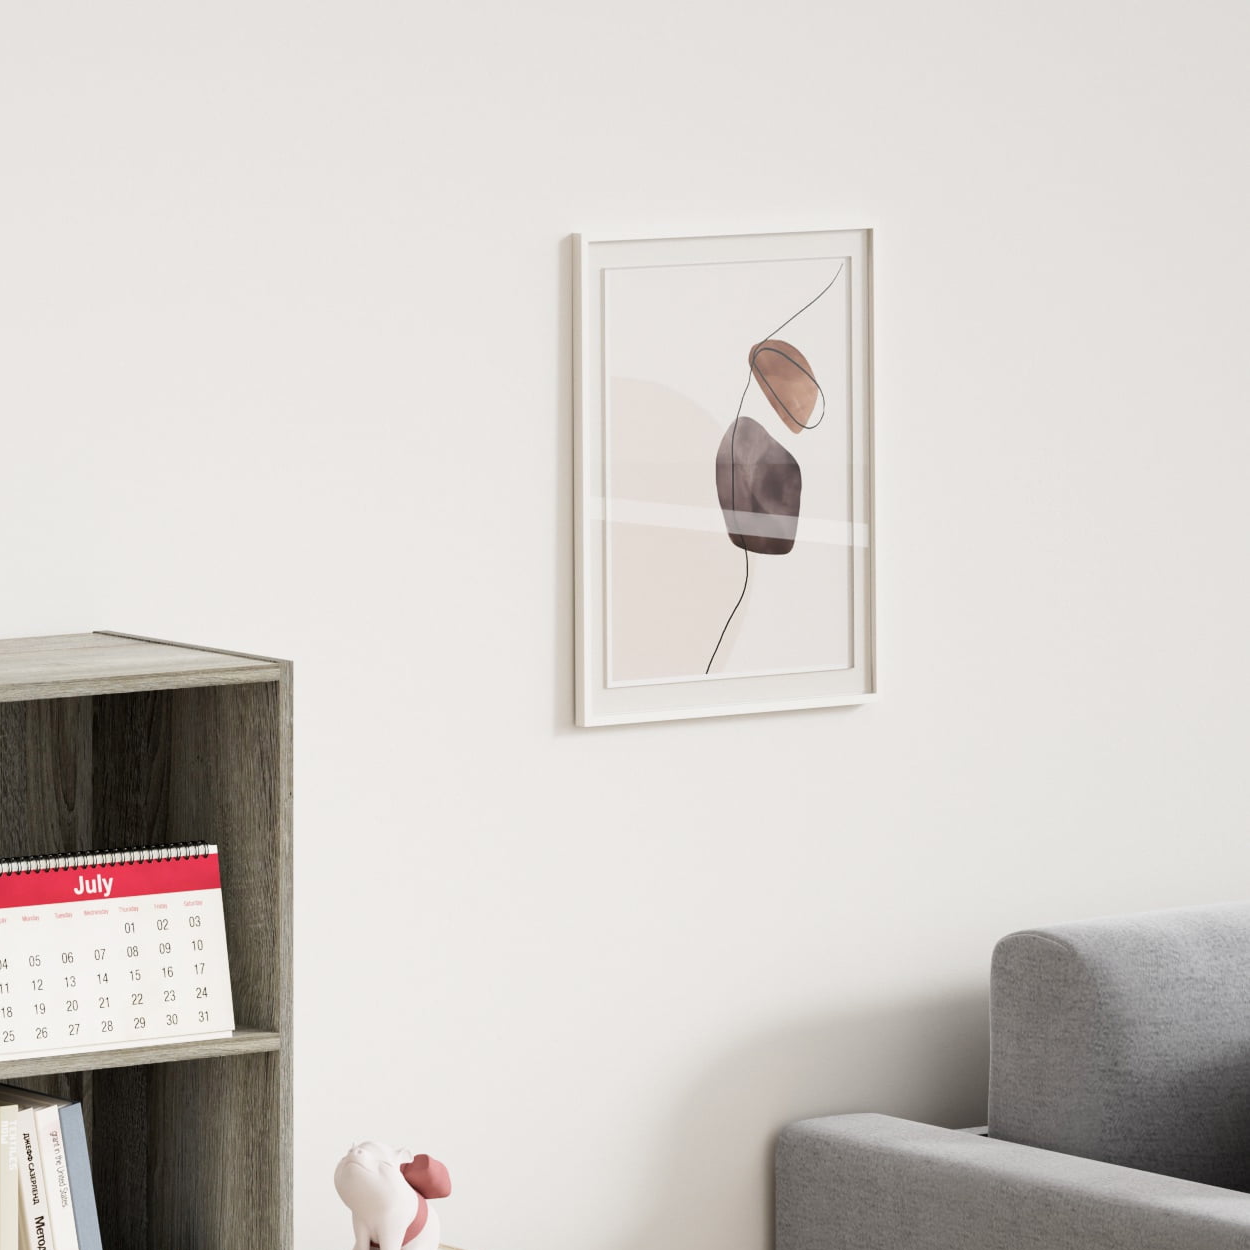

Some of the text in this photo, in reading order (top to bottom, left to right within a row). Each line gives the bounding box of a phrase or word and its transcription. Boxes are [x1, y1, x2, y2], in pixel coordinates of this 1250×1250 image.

[73, 873, 114, 897] July
[125, 915, 201, 934] 01 02 03
[29, 954, 41, 967] 05
[62, 951, 74, 964] 06
[95, 948, 106, 961] 07
[127, 945, 139, 958] 08
[160, 942, 171, 955] 09
[191, 939, 204, 951] 10
[31, 979, 44, 991] 12
[64, 975, 77, 988] 13
[96, 972, 109, 985] 14
[129, 969, 141, 981] 15
[161, 966, 174, 978] 16
[194, 962, 205, 975] 17
[0, 986, 208, 1018] 18 19 20 21 22 23 24
[3, 1010, 209, 1043] 25 26 27 28 29 30 31
